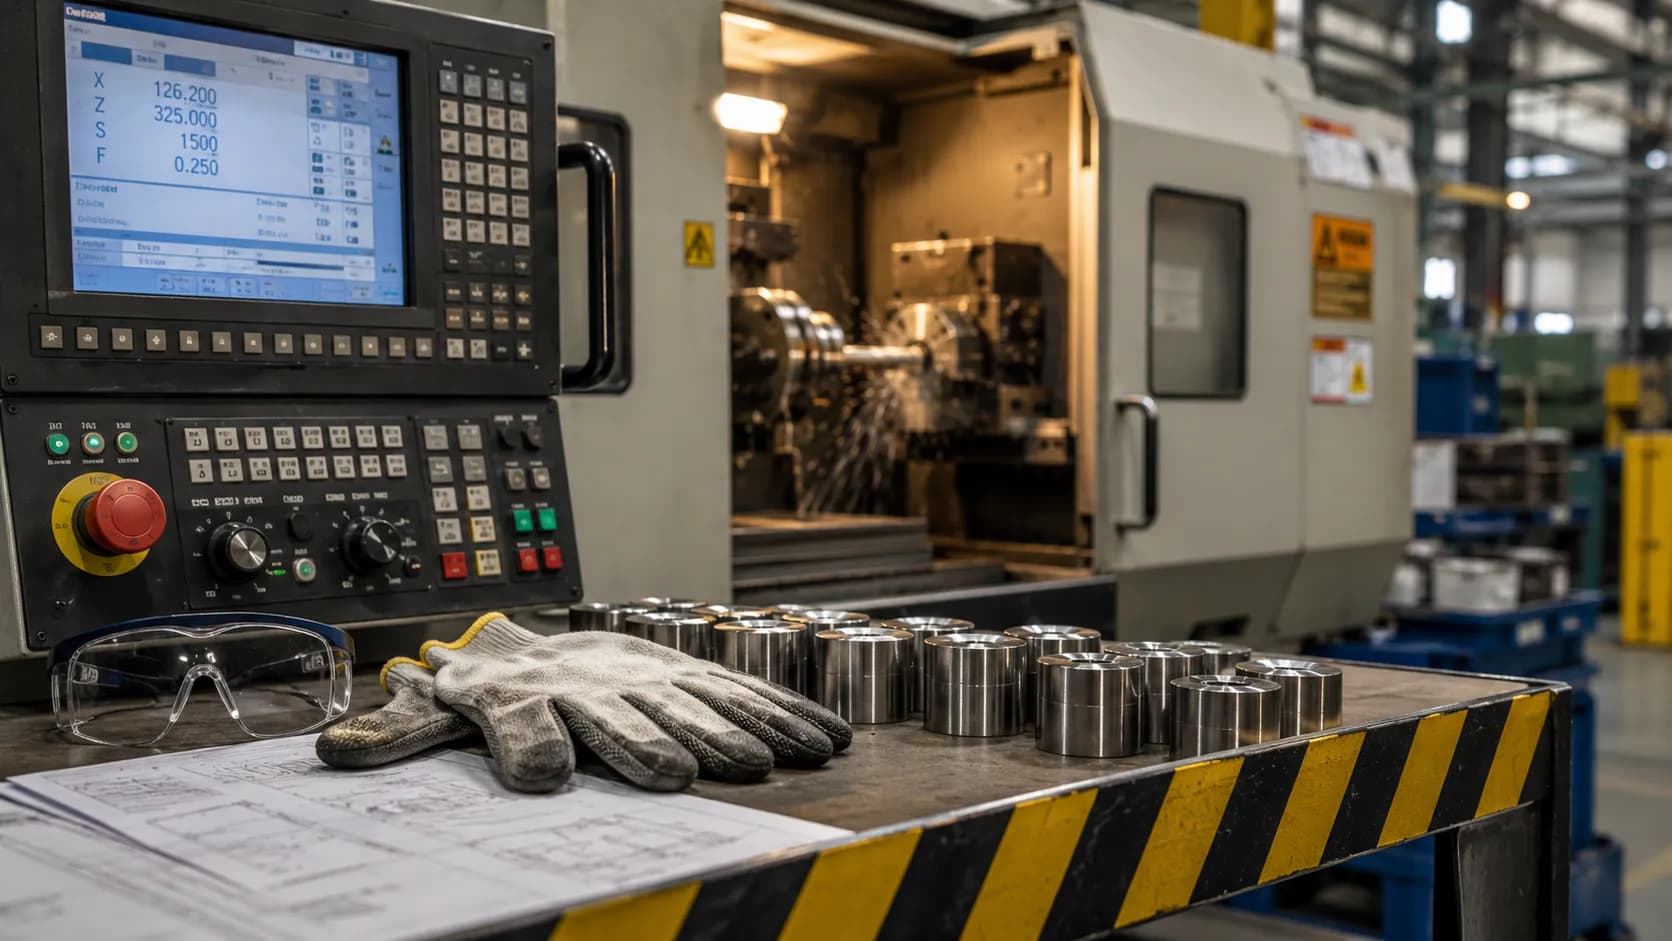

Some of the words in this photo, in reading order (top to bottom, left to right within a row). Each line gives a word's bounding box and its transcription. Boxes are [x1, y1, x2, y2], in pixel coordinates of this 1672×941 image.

[94, 71, 104, 88] X
[154, 81, 217, 105] 126.200
[95, 96, 105, 113] Z
[154, 105, 217, 128] 325.000
[95, 121, 106, 138] S
[181, 133, 218, 152] 1500
[97, 147, 106, 164] F
[174, 156, 218, 176] 0.250
